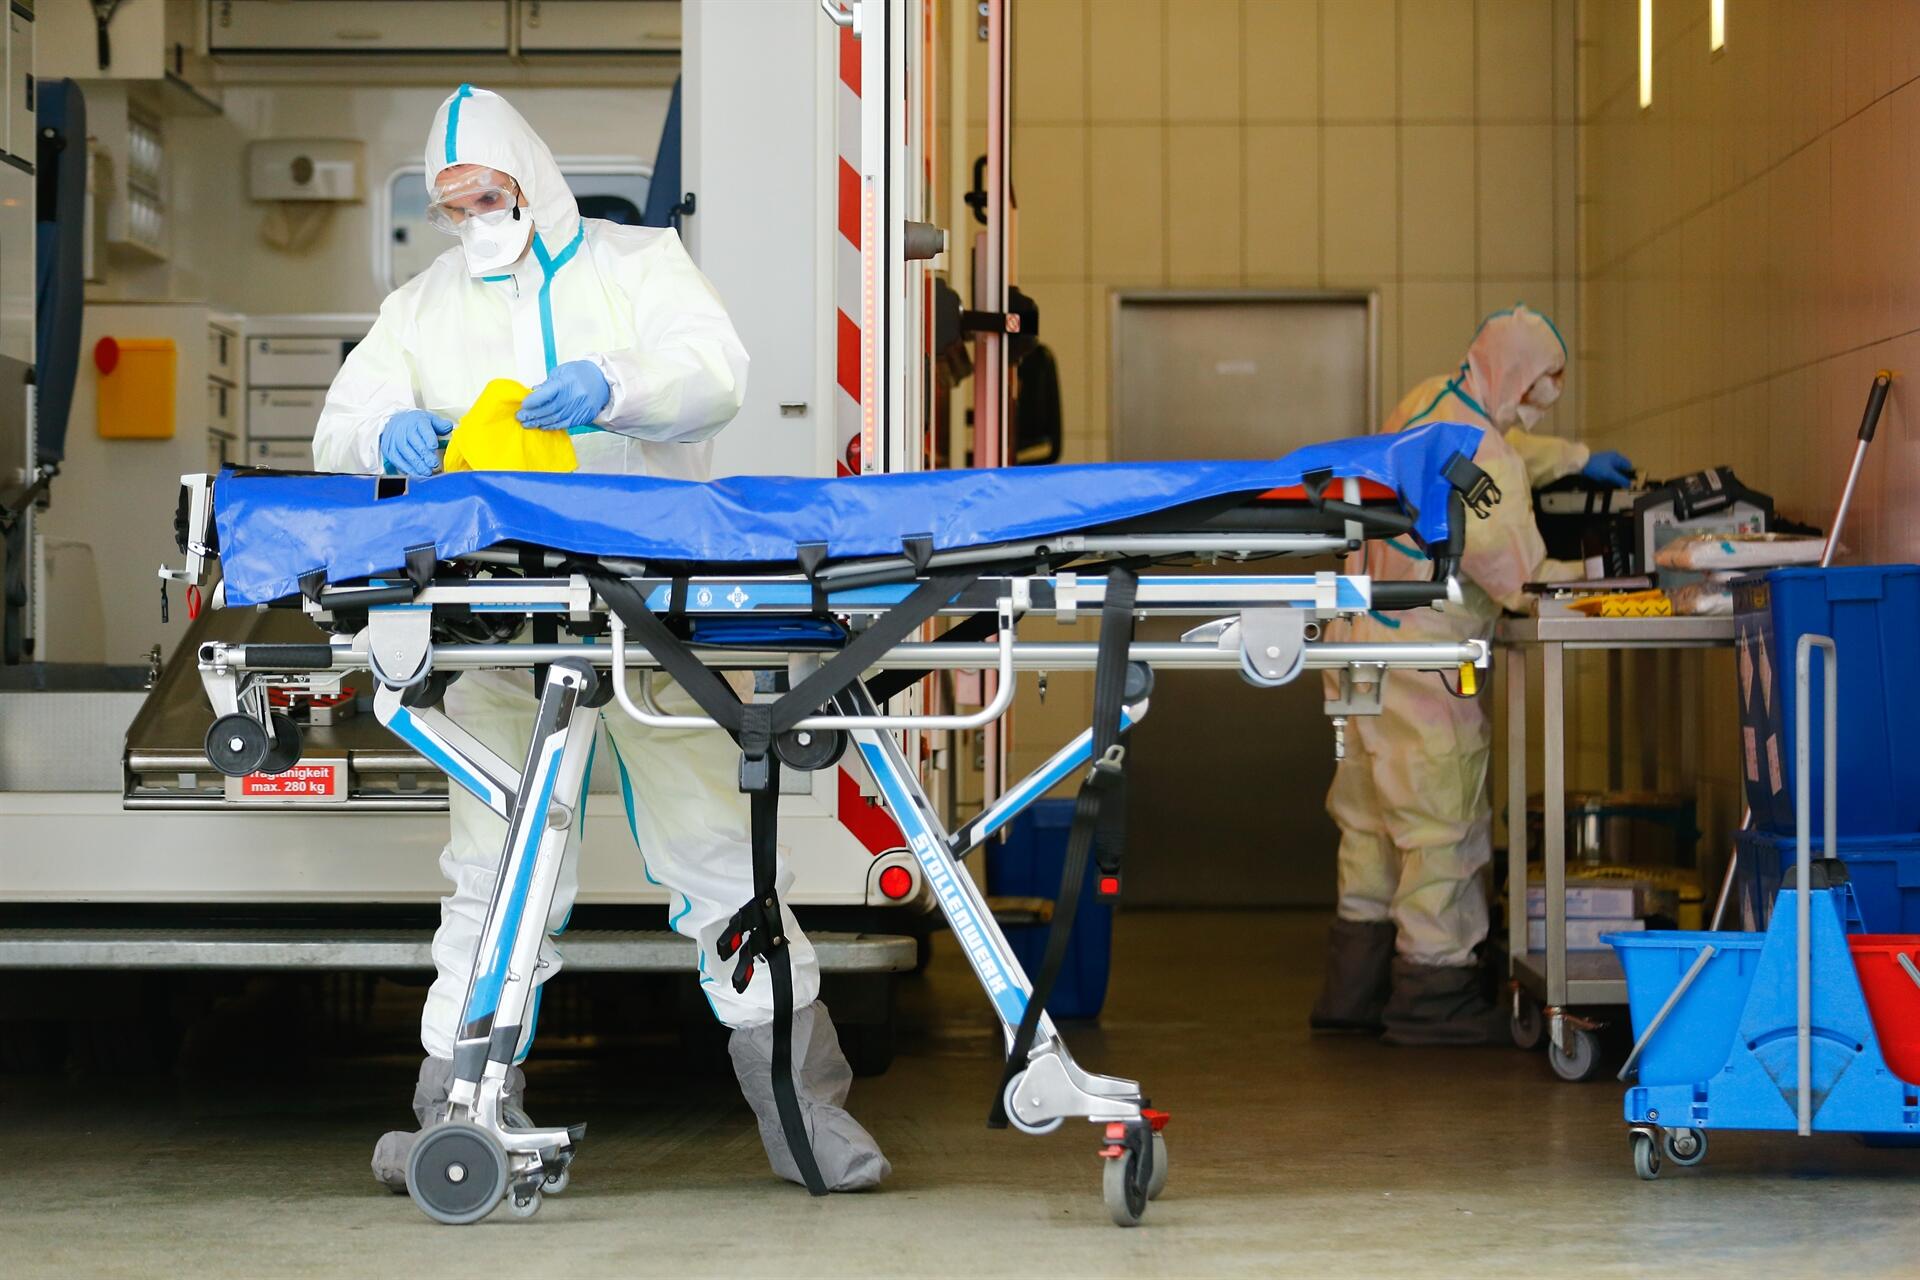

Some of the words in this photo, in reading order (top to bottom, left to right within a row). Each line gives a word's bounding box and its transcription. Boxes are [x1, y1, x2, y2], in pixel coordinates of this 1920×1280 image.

[250, 768, 329, 780] raghigkeit
[251, 783, 281, 792] max.
[284, 781, 306, 792] 280
[309, 781, 326, 794] kg
